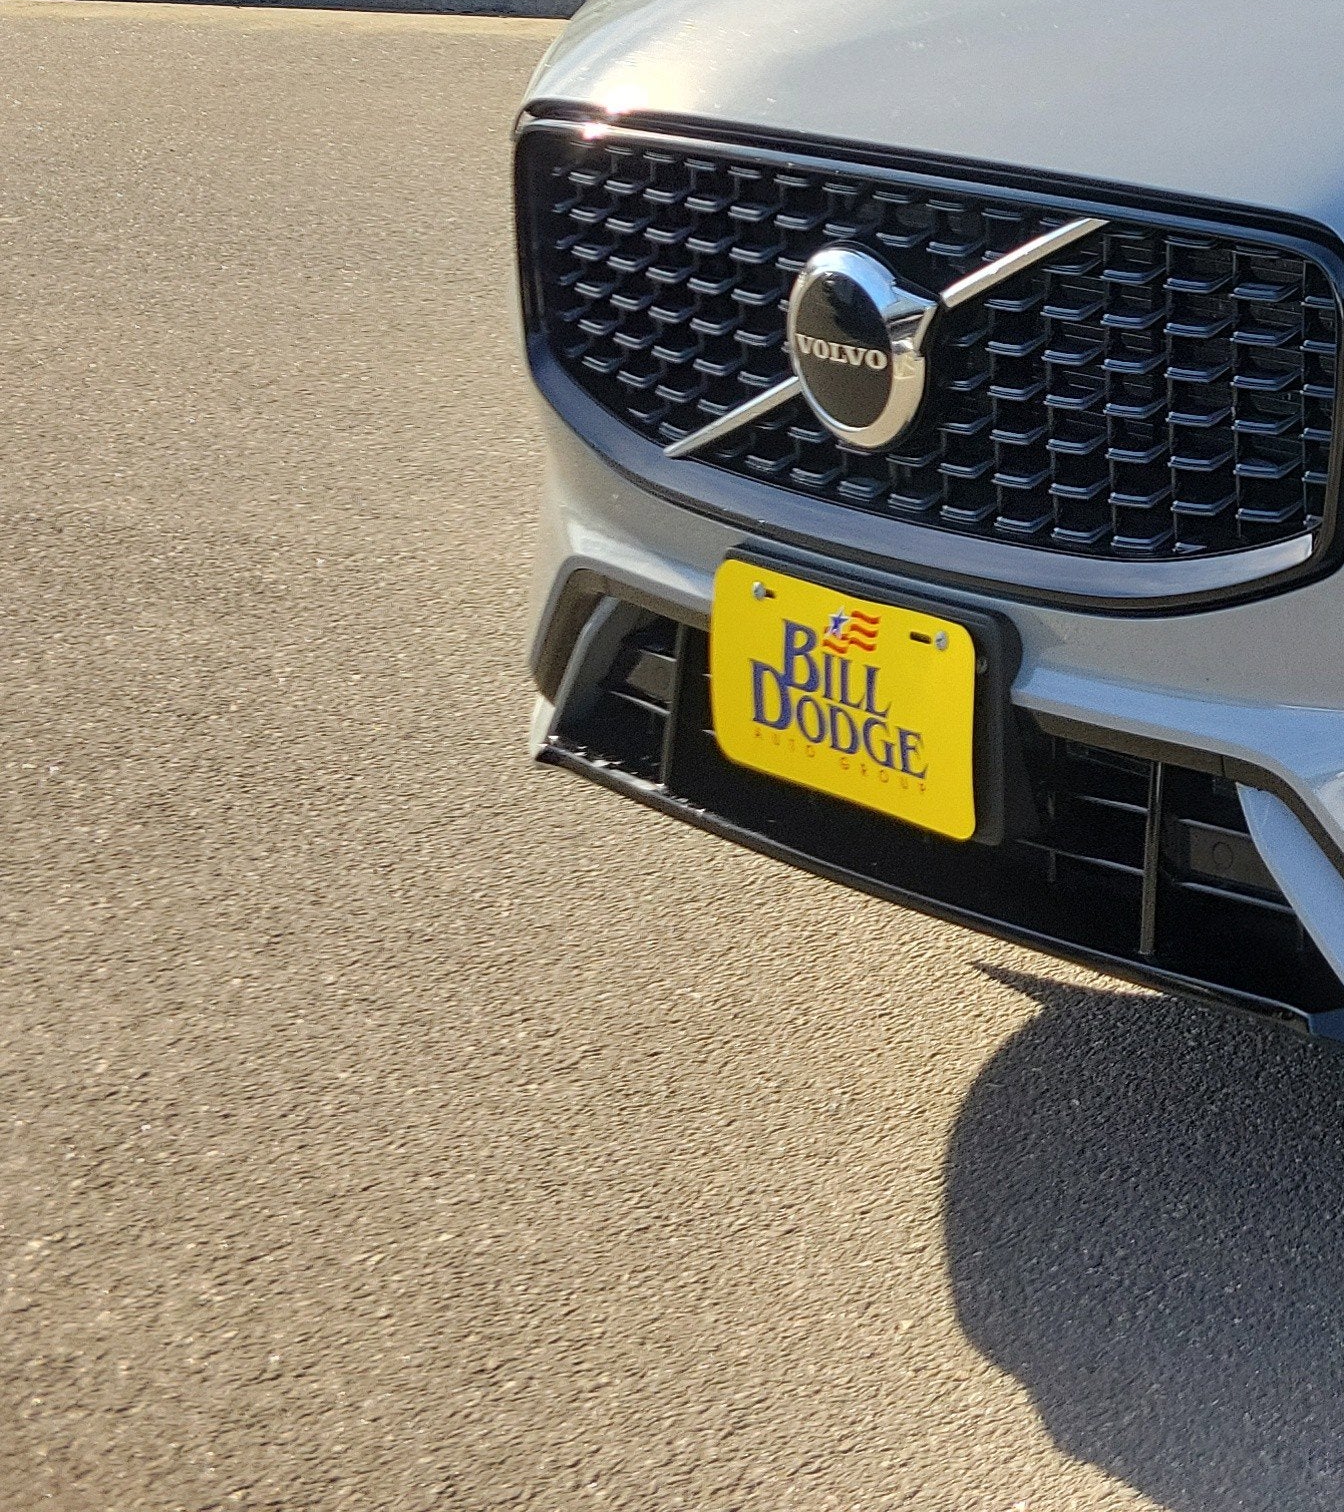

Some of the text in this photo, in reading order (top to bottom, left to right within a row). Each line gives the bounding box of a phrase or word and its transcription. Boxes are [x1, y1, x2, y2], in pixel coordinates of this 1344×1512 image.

[796, 333, 888, 370] VOLVO
[782, 617, 893, 718] BILL
[750, 658, 930, 779] DODGE
